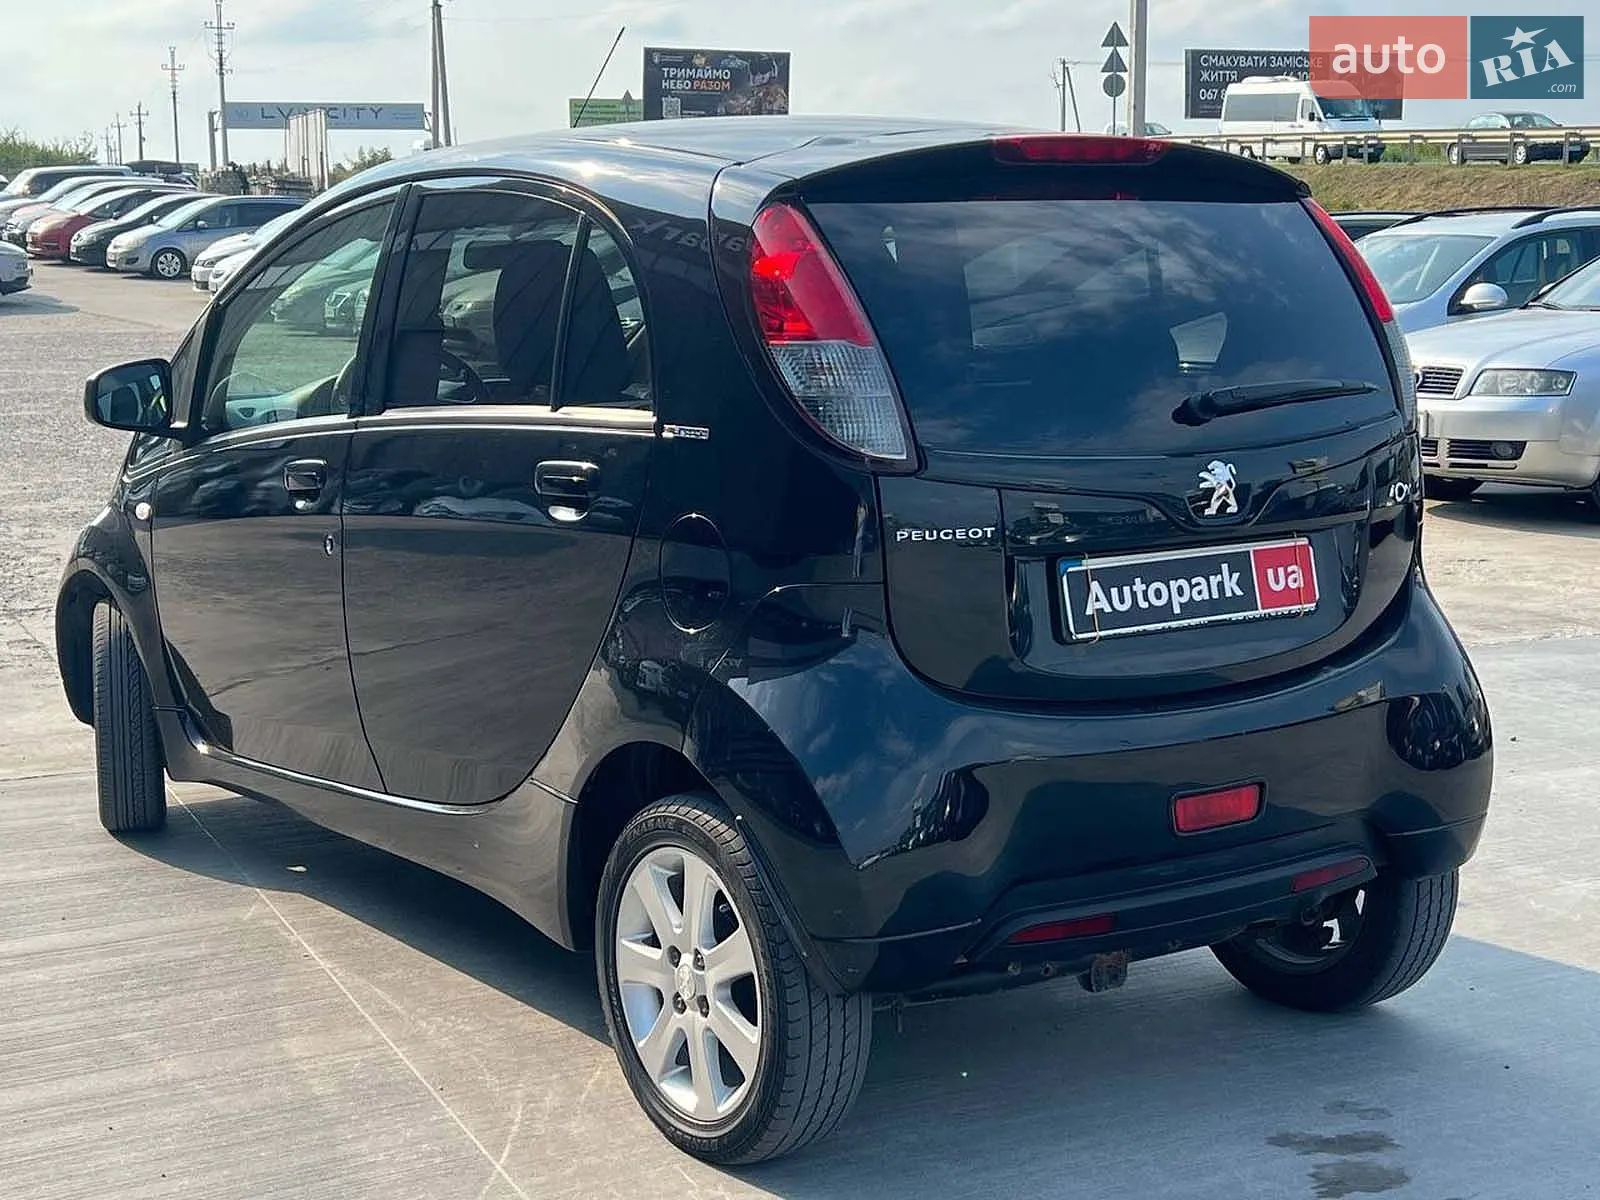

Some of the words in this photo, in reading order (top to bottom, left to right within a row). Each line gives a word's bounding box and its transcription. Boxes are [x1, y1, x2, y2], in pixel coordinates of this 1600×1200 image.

[1200, 55, 1267, 67] СМАКУВАТИ
[1270, 56, 1323, 68] ЗАМІСЬКЕ
[661, 66, 731, 79] ТРИМАЙМО
[1200, 70, 1238, 82] ЖИТТЯ
[661, 80, 691, 90] НЕБО
[693, 80, 731, 90] РАЗОМ
[1199, 89, 1217, 100] 067
[327, 107, 384, 120] CITY
[895, 526, 995, 542] PEUGEOT
[1084, 565, 1244, 616] Autopark
[1266, 567, 1305, 592] ua
